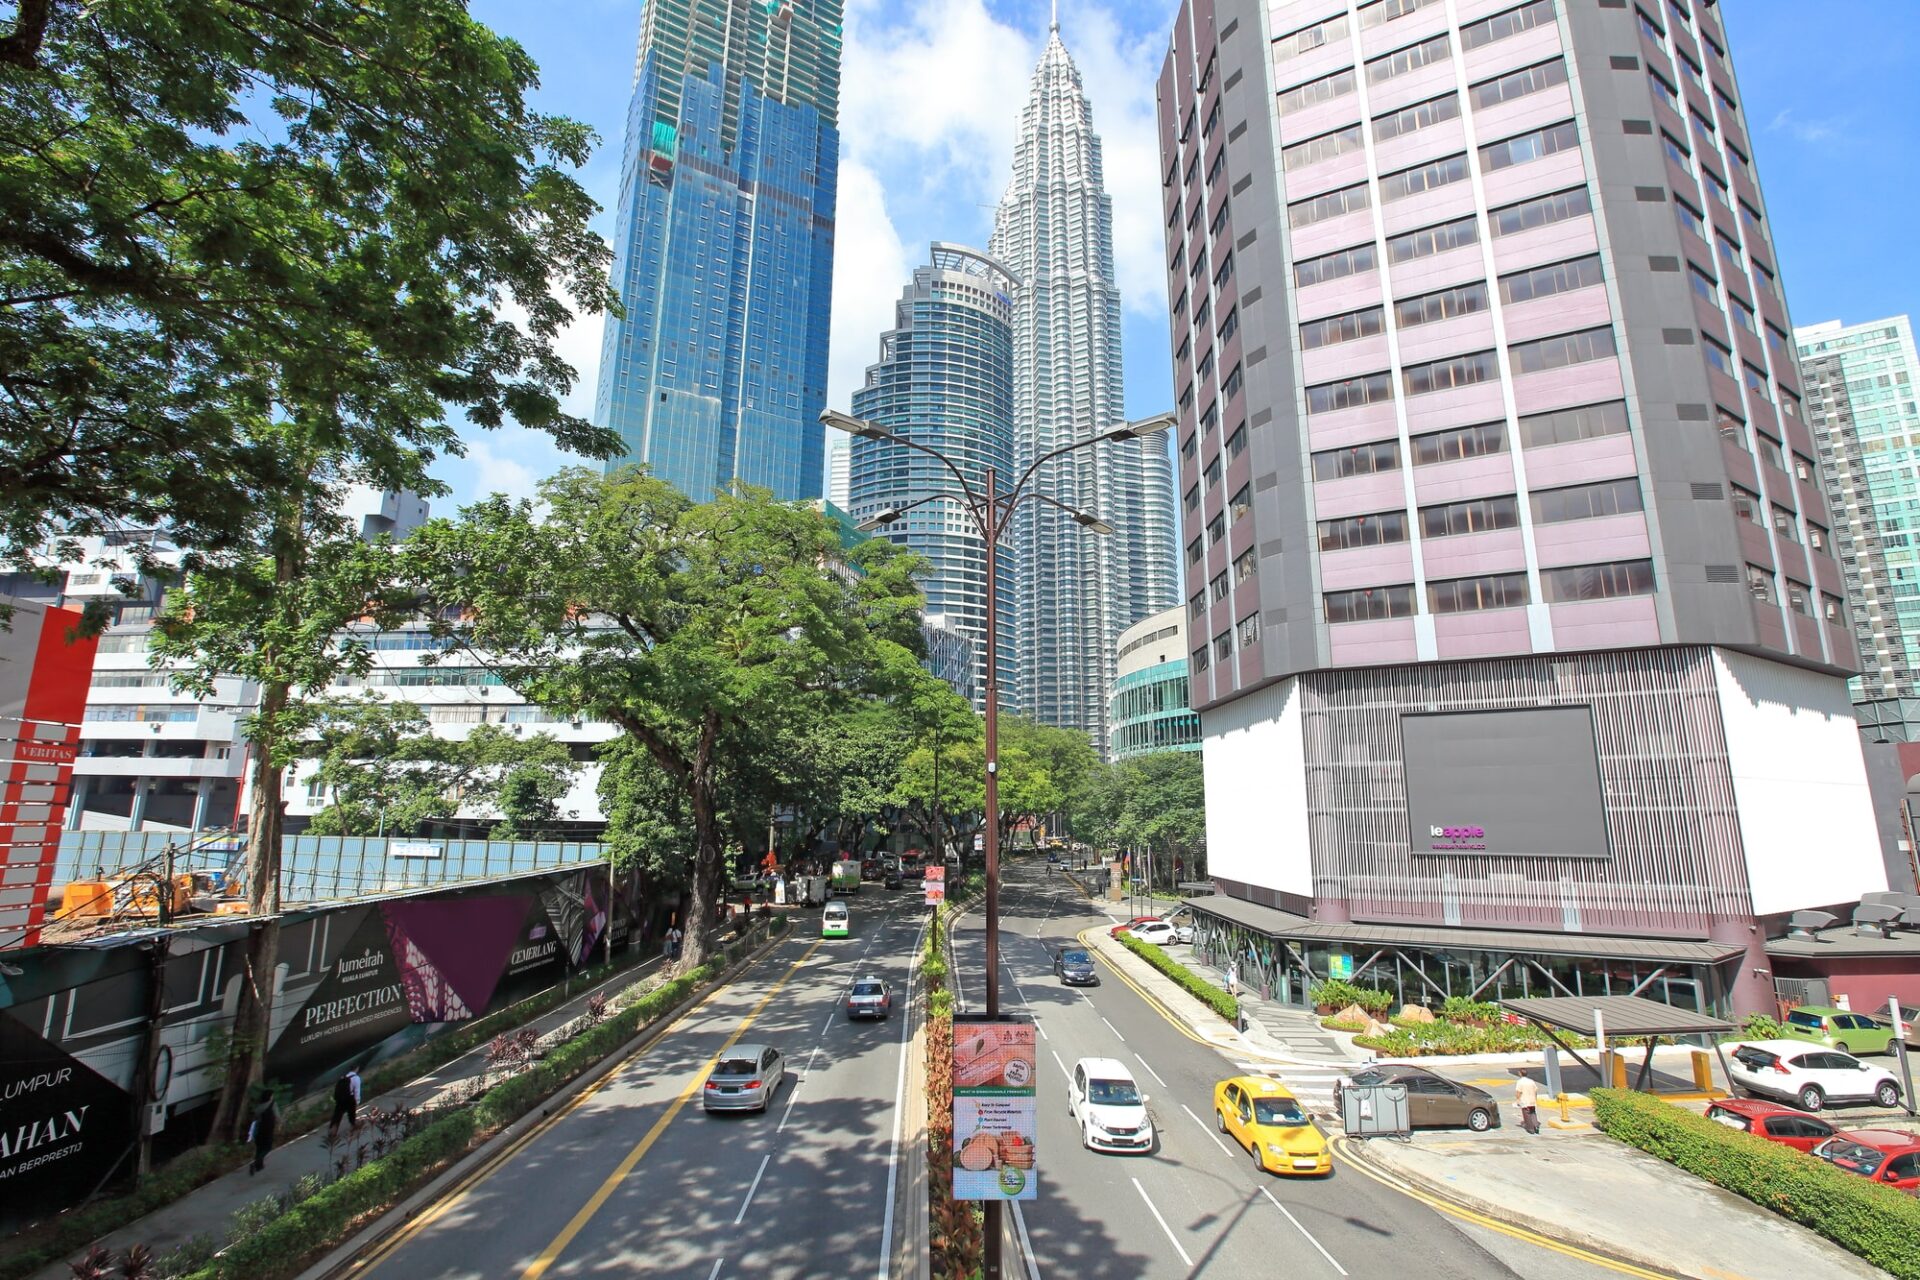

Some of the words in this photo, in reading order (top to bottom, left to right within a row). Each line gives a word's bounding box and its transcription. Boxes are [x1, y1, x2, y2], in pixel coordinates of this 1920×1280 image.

[22, 746, 72, 759] VERITAS
[336, 948, 384, 979] Jumeirah
[304, 983, 402, 1029] PERFECTION
[324, 1023, 344, 1036] HOTELS
[0, 1067, 72, 1101] UMPUR
[19, 1142, 83, 1174] BERPRESTIJ
